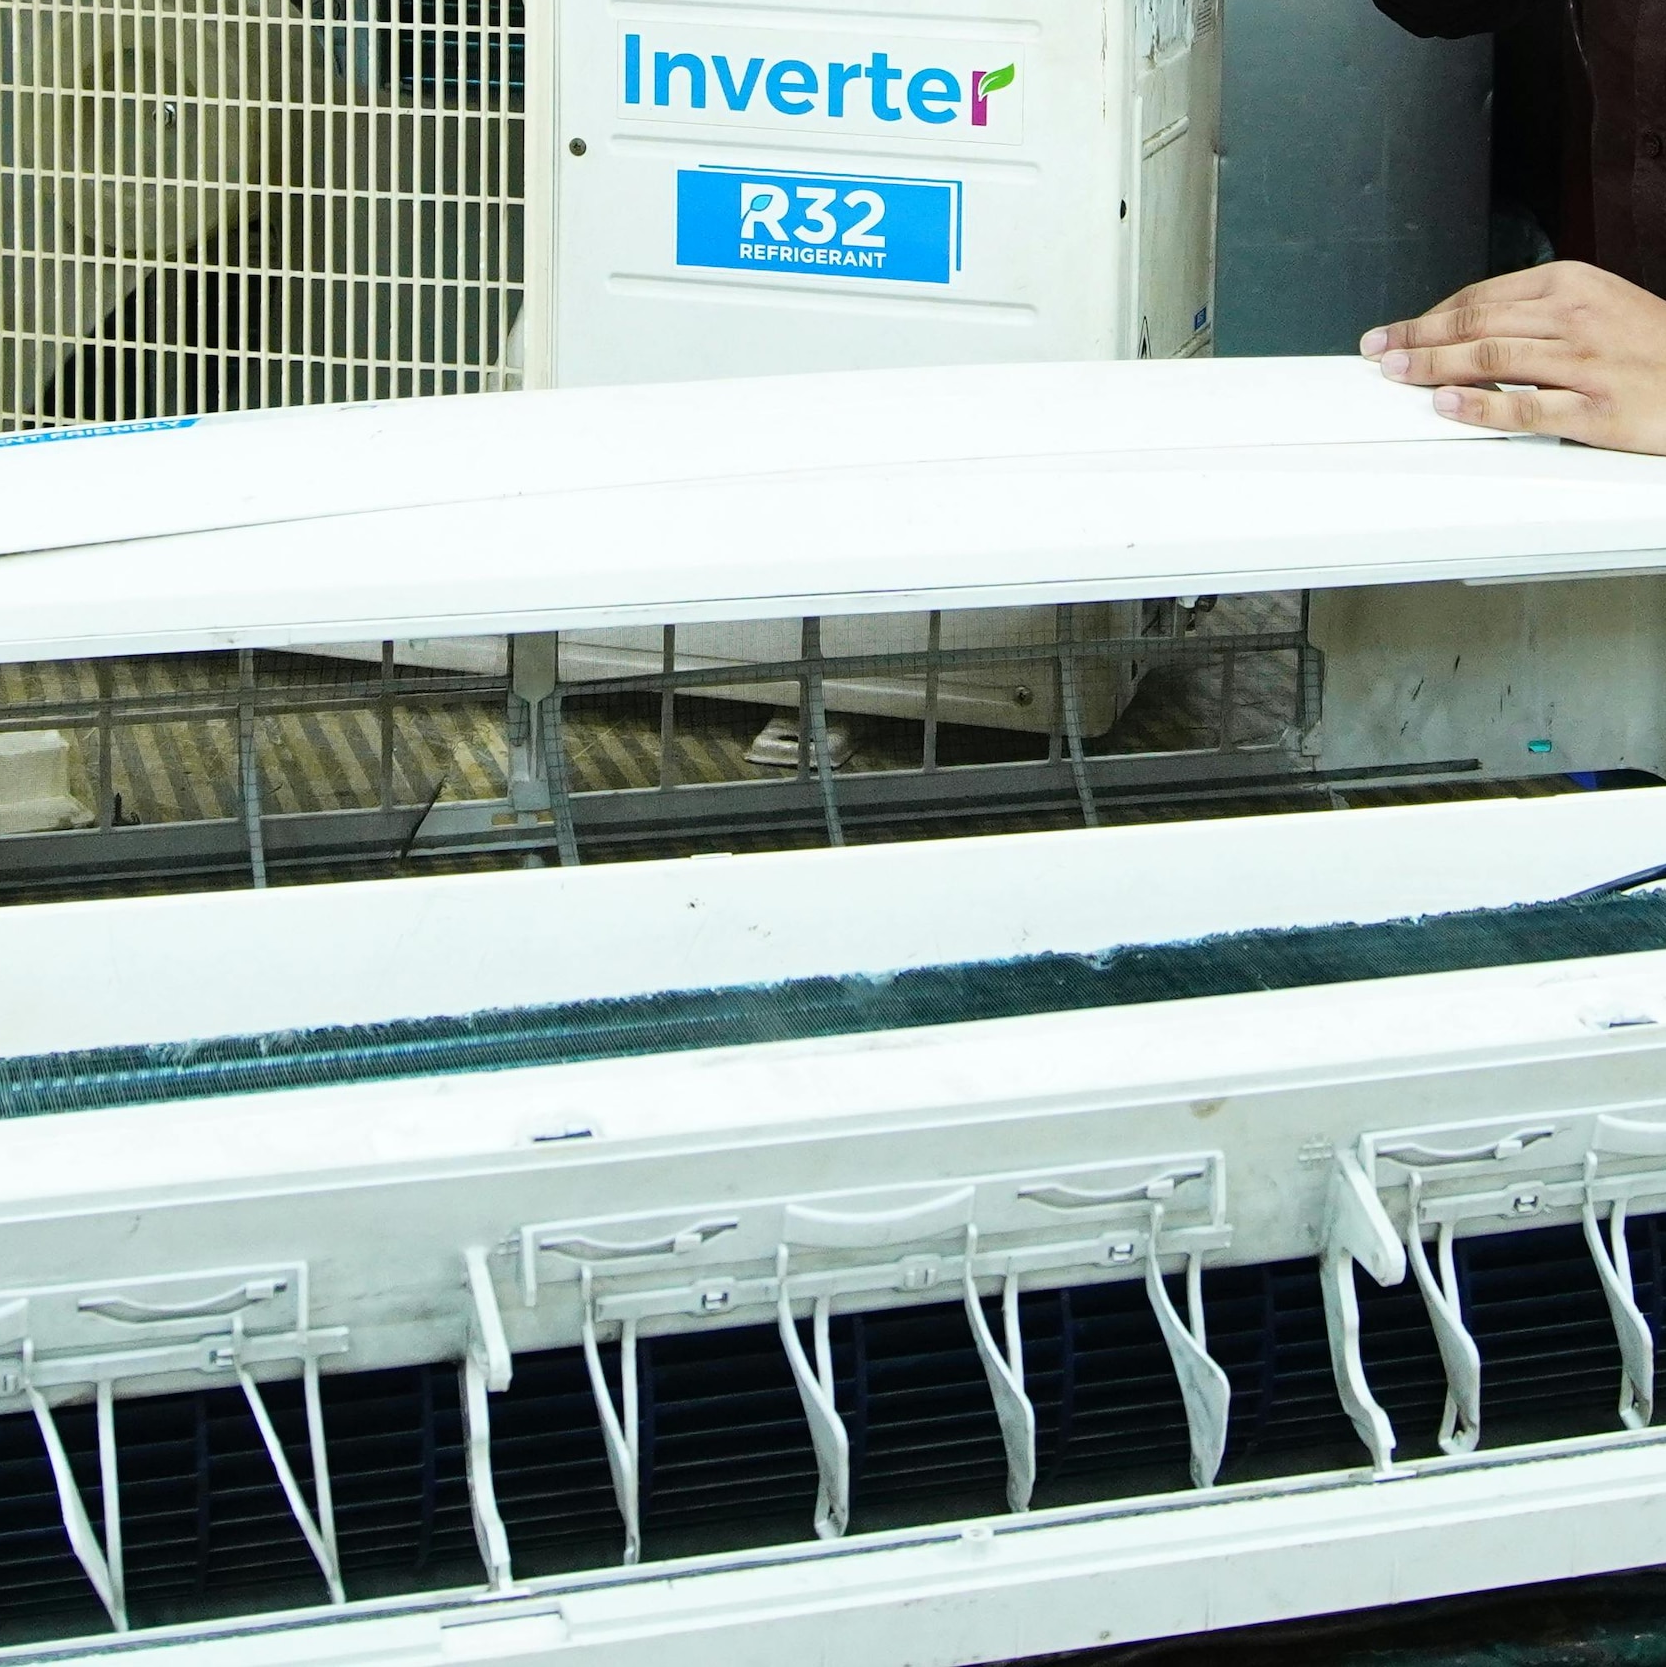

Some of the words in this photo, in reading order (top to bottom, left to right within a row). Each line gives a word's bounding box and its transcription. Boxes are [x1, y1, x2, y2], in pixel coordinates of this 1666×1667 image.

[625, 33, 1015, 126] Inverter
[739, 183, 887, 249] R32
[739, 246, 887, 270] REFRIGERANT
[49, 419, 181, 441] FRIENDLY
